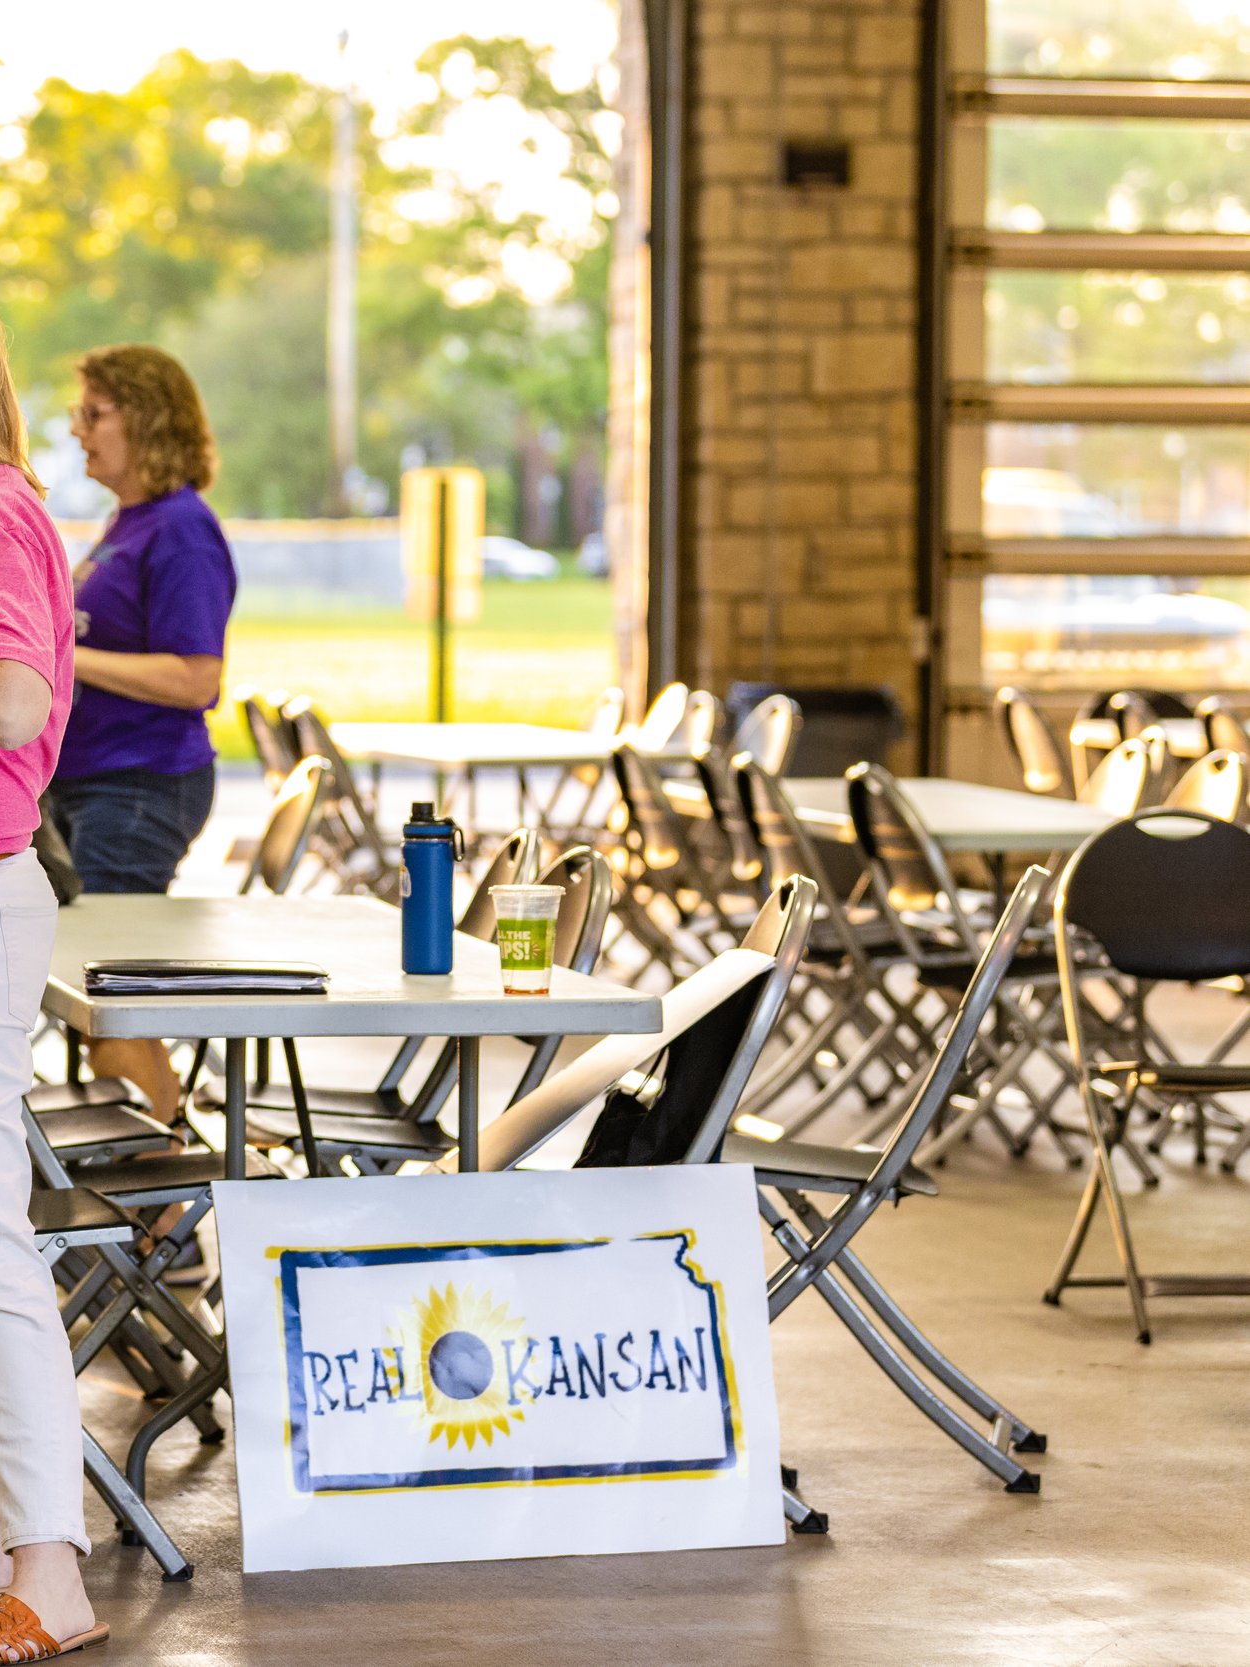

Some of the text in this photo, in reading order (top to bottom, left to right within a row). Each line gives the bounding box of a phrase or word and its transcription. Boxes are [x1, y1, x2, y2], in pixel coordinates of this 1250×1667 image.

[507, 930, 531, 940] THE
[303, 1326, 708, 1416] REAL KANSAN
